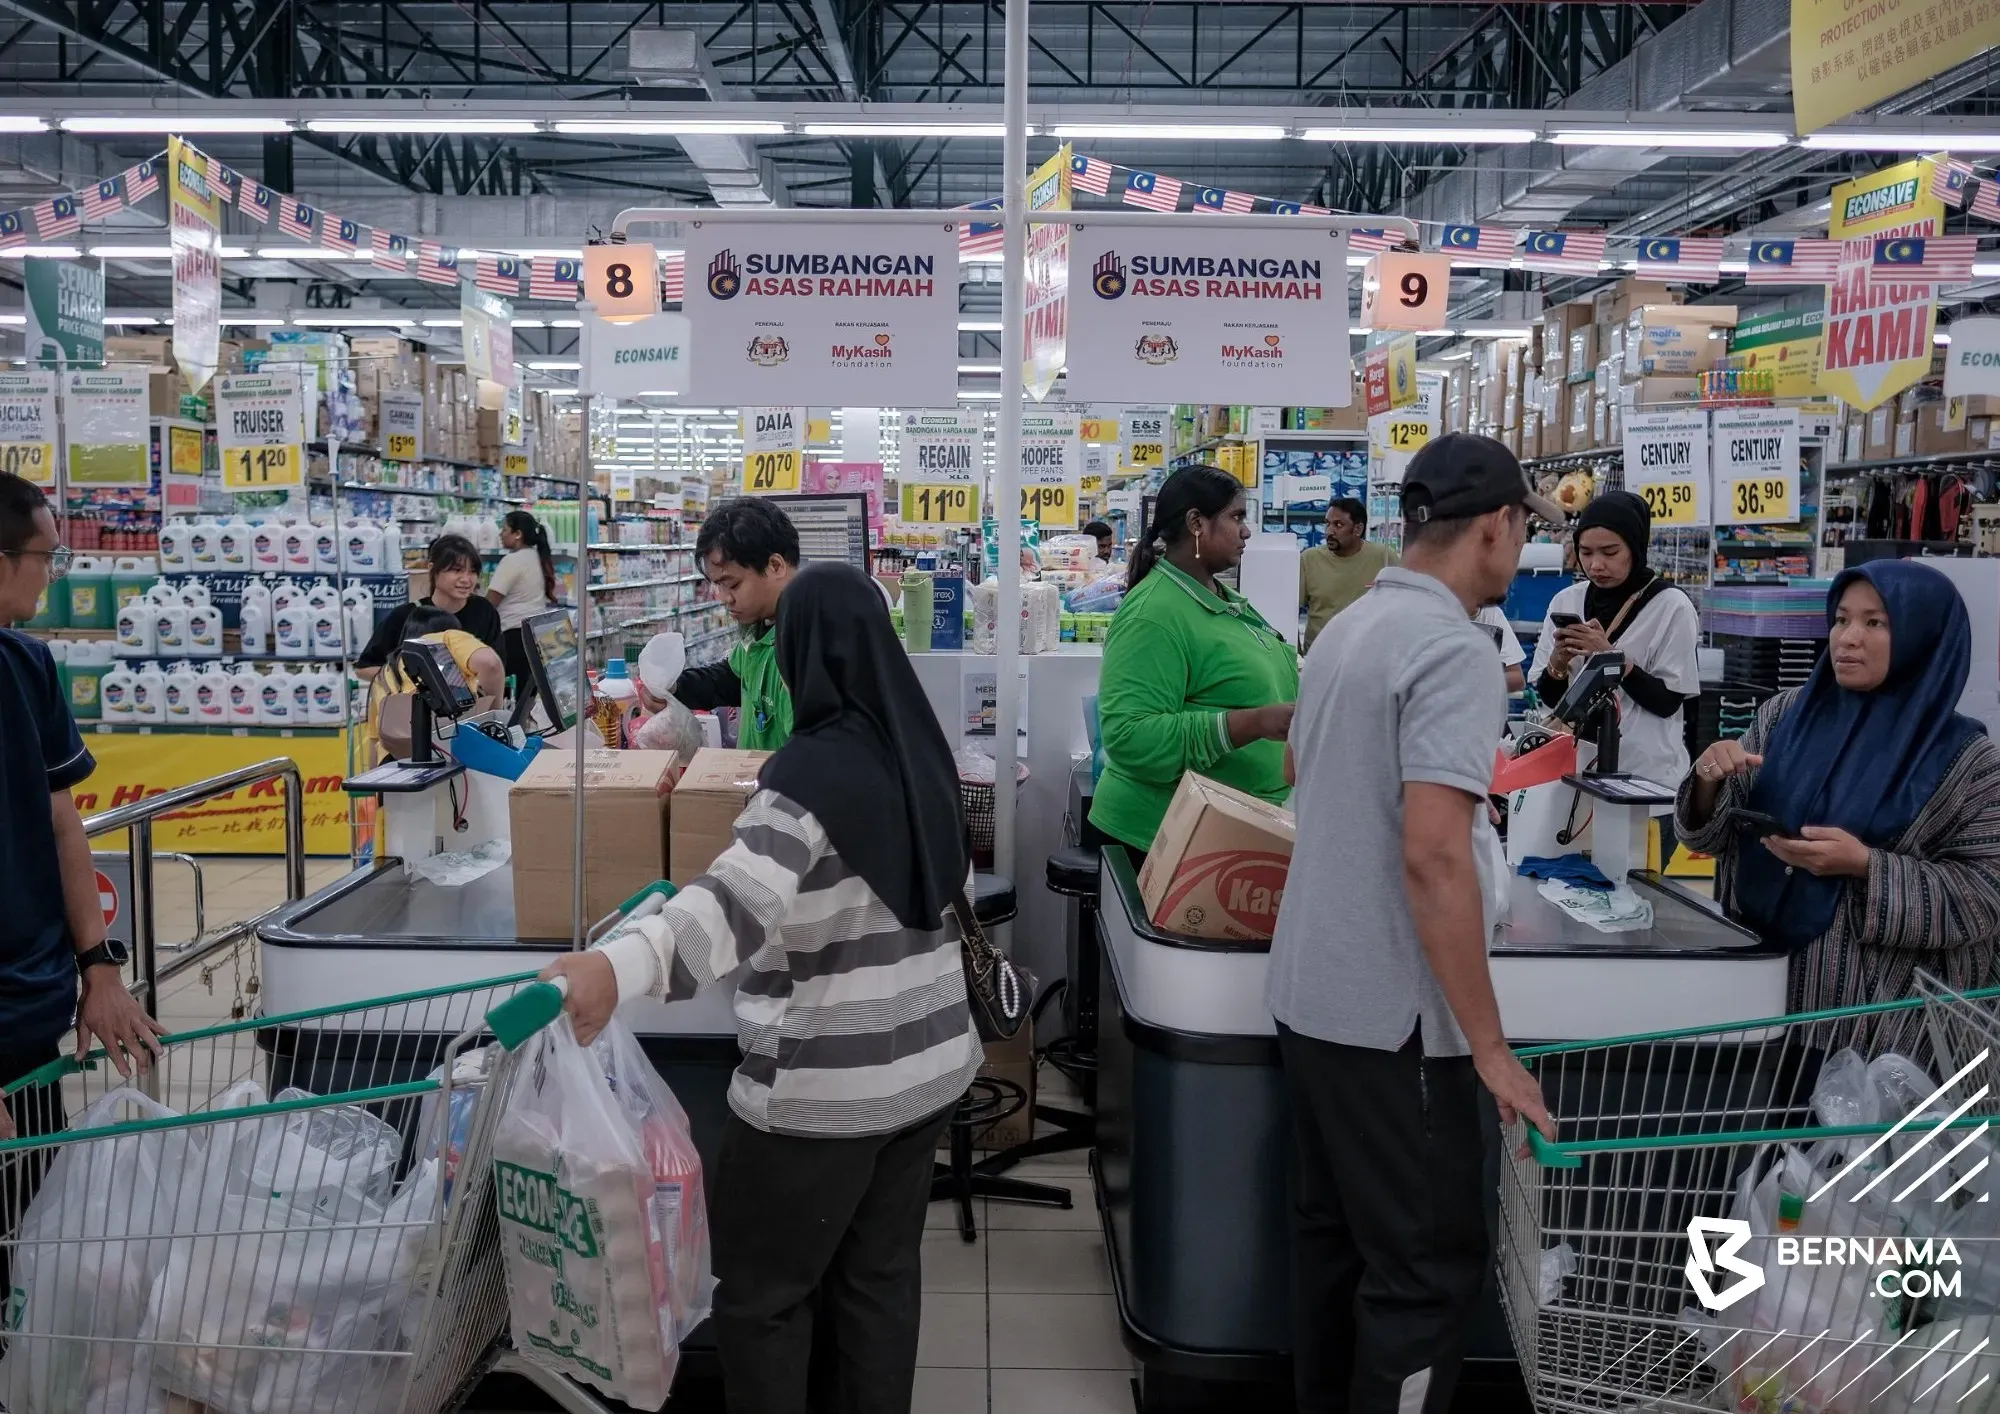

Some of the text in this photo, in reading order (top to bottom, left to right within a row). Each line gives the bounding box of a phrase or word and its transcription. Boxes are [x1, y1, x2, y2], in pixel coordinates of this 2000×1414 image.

[1820, 3, 1886, 49] PROTECTION
[1846, 180, 1916, 219] ECONSAVE
[745, 254, 934, 276] SUMBANGAN
[1130, 255, 1322, 280] SUMBANGAN
[606, 263, 634, 299] 8
[744, 277, 933, 297] ASAS RAHMAH
[1130, 278, 1322, 301] ASAS RAHMAH
[1400, 272, 1428, 308] 9
[1648, 329, 1682, 338] molfix
[1825, 304, 1929, 370] KAMI
[614, 346, 679, 365] ECONSAVE
[832, 345, 892, 361] MyKasih
[832, 360, 892, 368] foundation
[1221, 345, 1283, 361] MyKasih
[1682, 350, 1697, 358] DRY
[1961, 351, 2000, 367] ECON
[1221, 360, 1283, 369] foundation
[233, 409, 285, 433] FRUISER
[755, 412, 793, 432] DAIA
[1038, 428, 1058, 436] HARGA
[1059, 428, 1074, 436] KAMI
[1132, 420, 1161, 430] E&S
[1390, 423, 1428, 445] 1290
[919, 445, 971, 469] REGAIN
[1021, 447, 1063, 466] HOOPEE
[1133, 444, 1162, 461] 2290
[1640, 441, 1691, 466] CENTURY
[1731, 437, 1782, 462] CENTURY
[0, 446, 42, 477] 070
[753, 453, 793, 488] 2070
[1021, 466, 1064, 475] PPEE PANTS
[1645, 485, 1691, 518] 23.50
[1737, 480, 1784, 515] 36.90
[934, 591, 951, 599] rex
[1227, 877, 1285, 917] Kas
